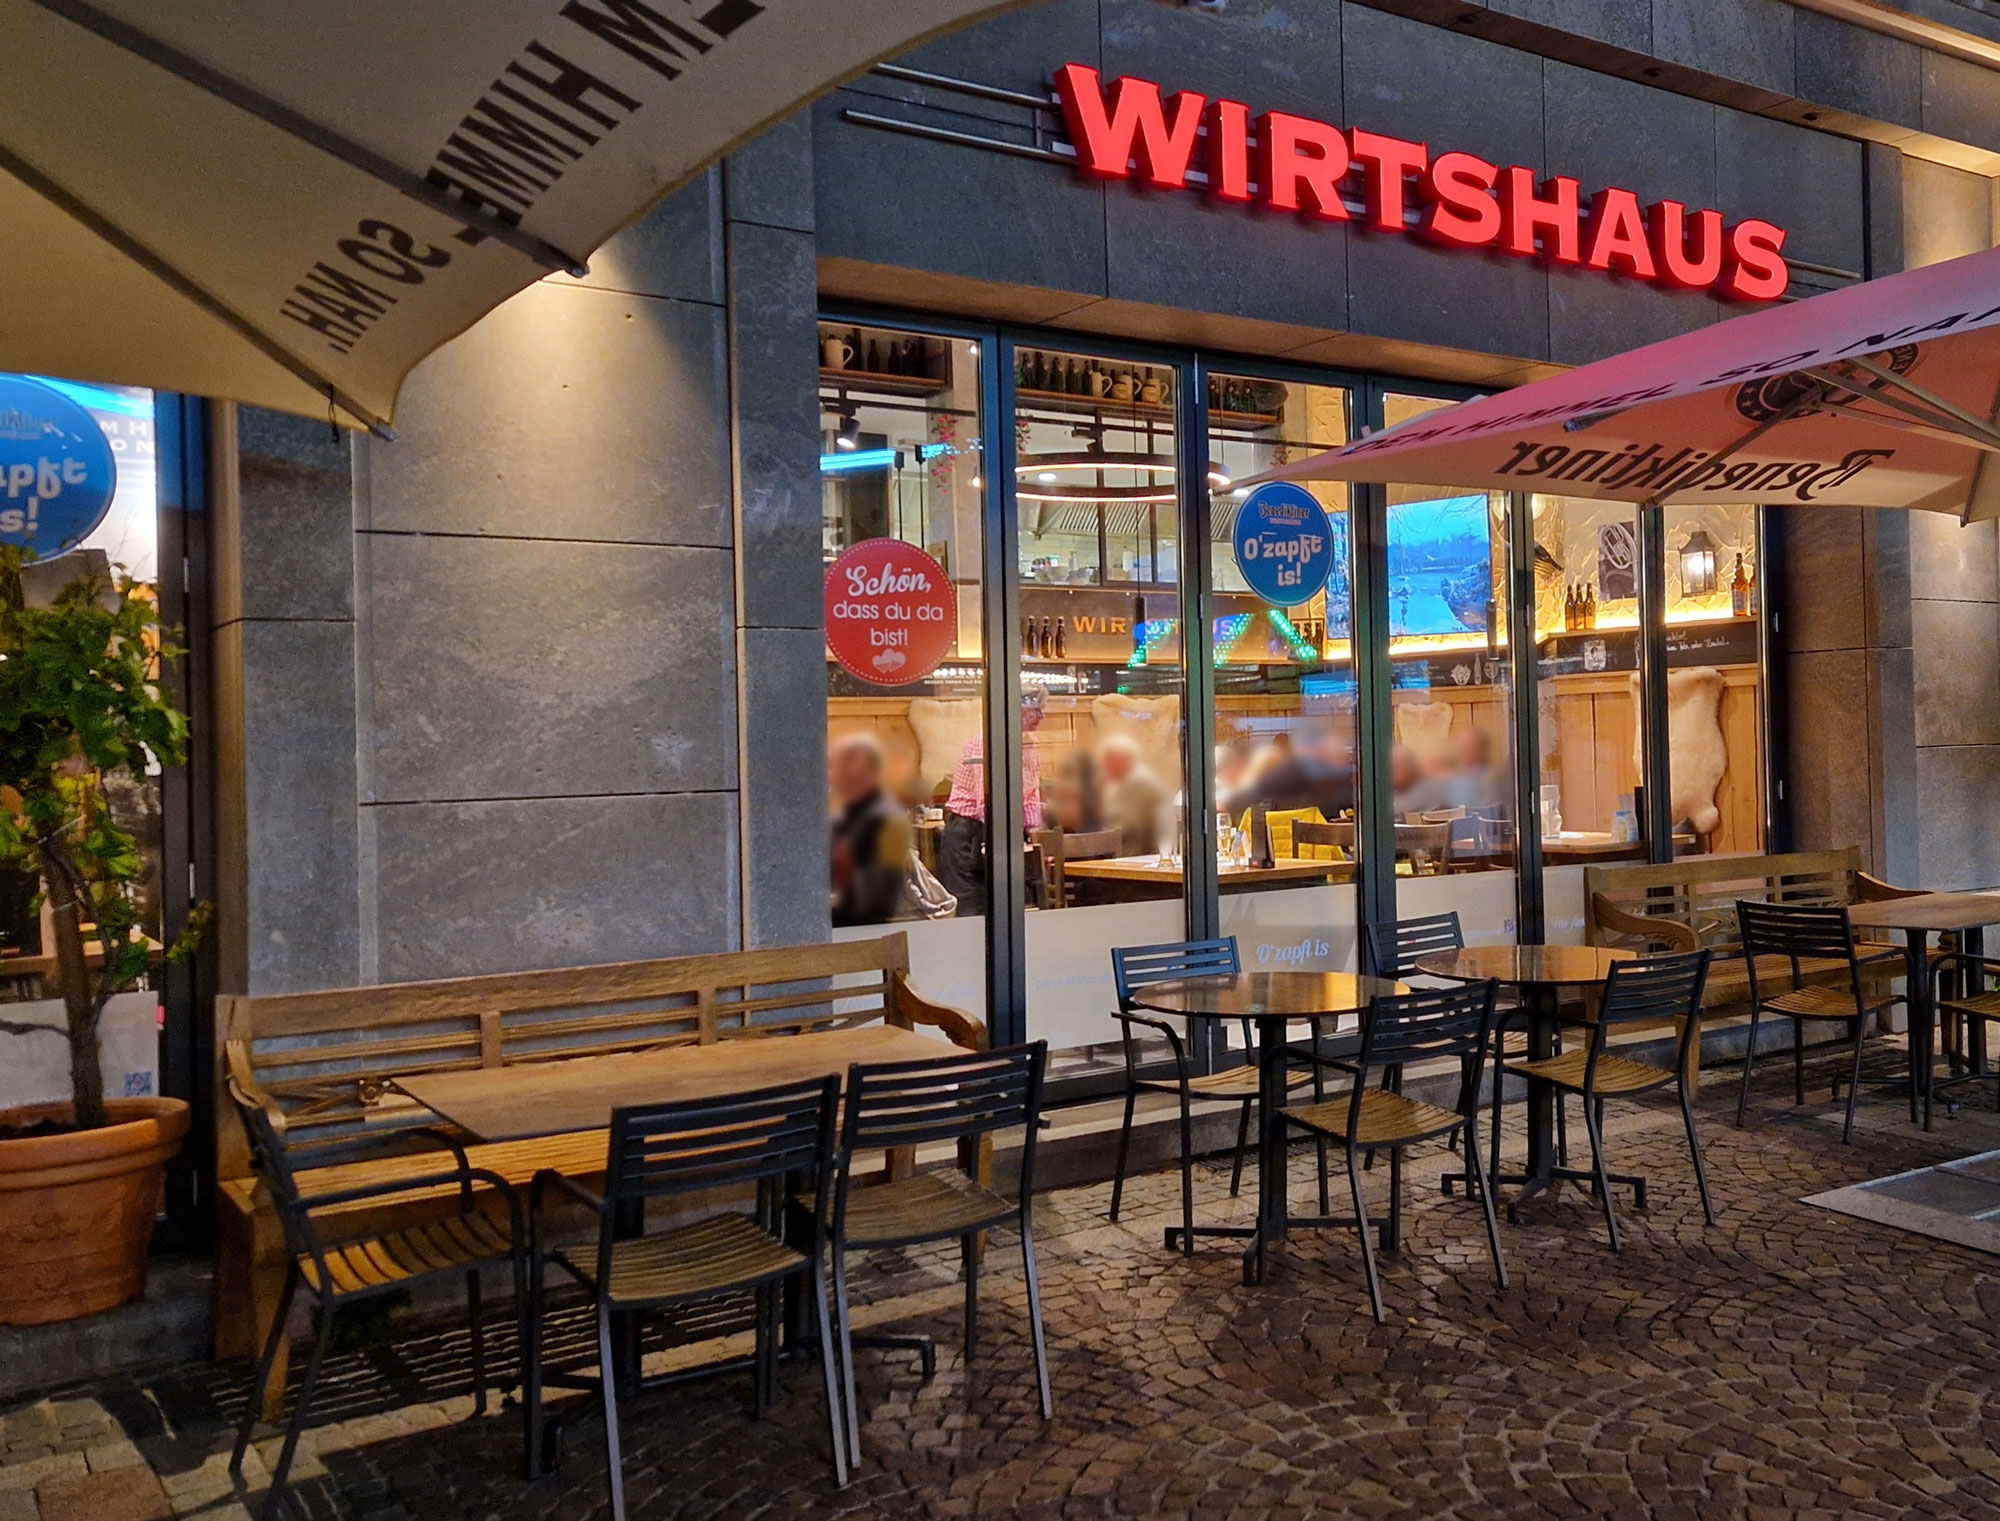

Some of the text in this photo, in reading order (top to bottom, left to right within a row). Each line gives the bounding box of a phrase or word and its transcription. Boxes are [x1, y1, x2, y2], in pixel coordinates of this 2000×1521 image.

[1054, 62, 1790, 299] WIRTSHAUS
[1699, 349, 1820, 386] SO
[845, 562, 932, 598] Schön,
[1277, 560, 1302, 587] is!
[832, 600, 944, 621] dass du da
[870, 627, 909, 647] bist!
[1315, 938, 1329, 957] is
